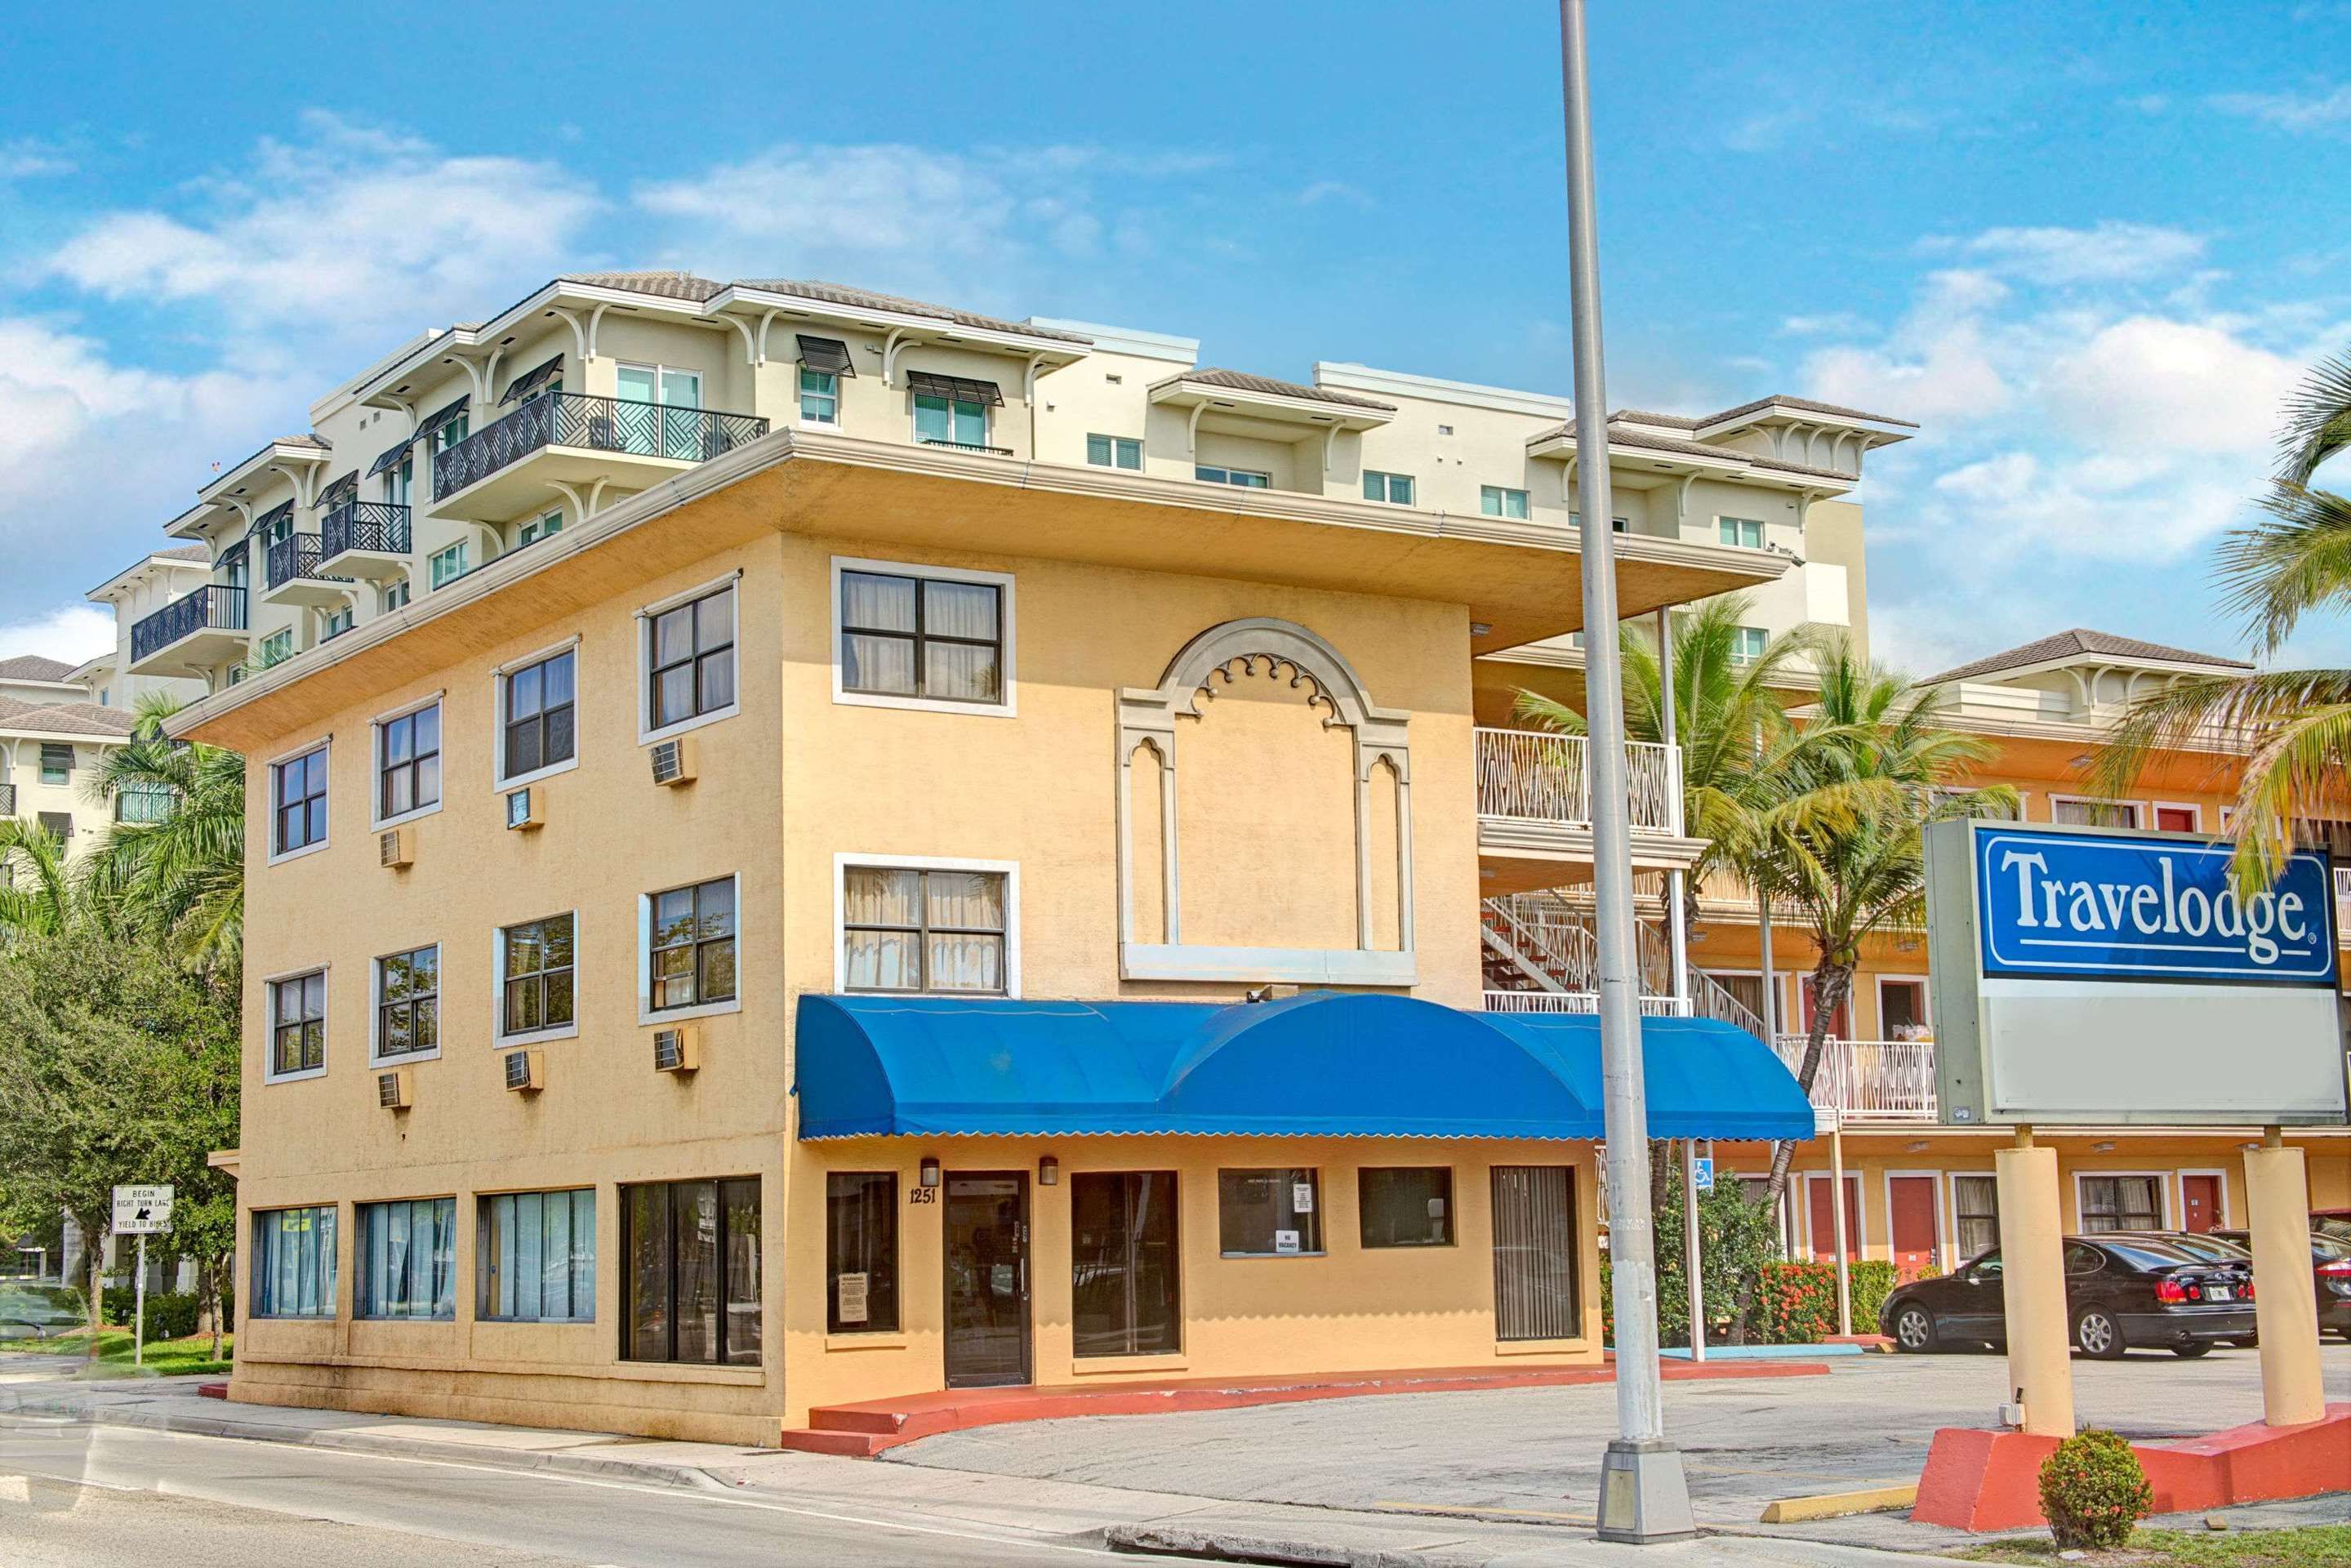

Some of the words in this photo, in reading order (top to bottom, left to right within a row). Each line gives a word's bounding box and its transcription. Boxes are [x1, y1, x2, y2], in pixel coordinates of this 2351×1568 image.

[2000, 850, 2306, 964] Travelodge
[132, 1190, 155, 1198] BEGIN
[910, 1187, 936, 1204] 1251
[117, 1200, 134, 1208] RIGHT
[118, 1220, 136, 1228] YIELD
[139, 1220, 147, 1228] TO
